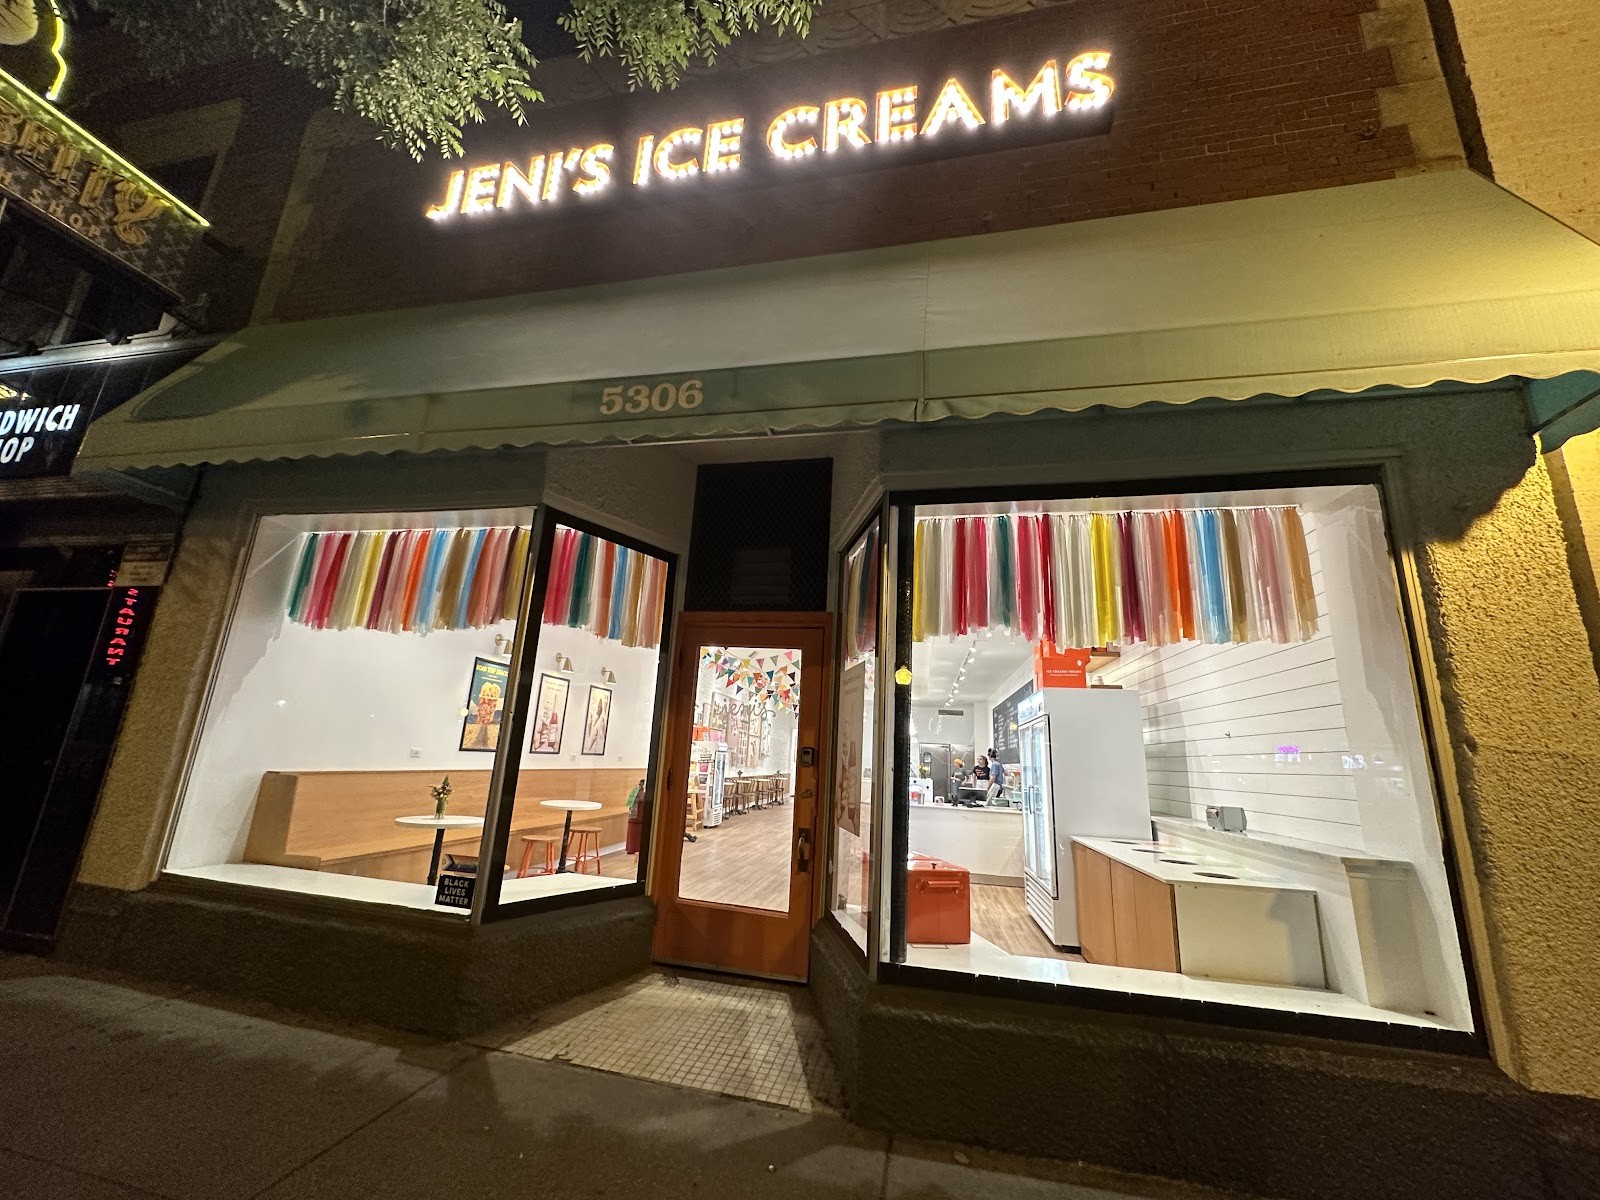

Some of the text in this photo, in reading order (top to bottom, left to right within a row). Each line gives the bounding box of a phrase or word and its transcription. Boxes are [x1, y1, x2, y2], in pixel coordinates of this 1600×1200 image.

[426, 49, 1117, 221] JENI'S ICE CREAMS
[30, 188, 101, 238] SHOP
[600, 379, 704, 415] 5306
[0, 403, 81, 436] DWICH
[0, 436, 35, 464] OP
[714, 698, 777, 723] jeni's
[444, 878, 470, 888] BLACK
[445, 887, 466, 896] LIVES
[438, 895, 469, 905] MATTER
